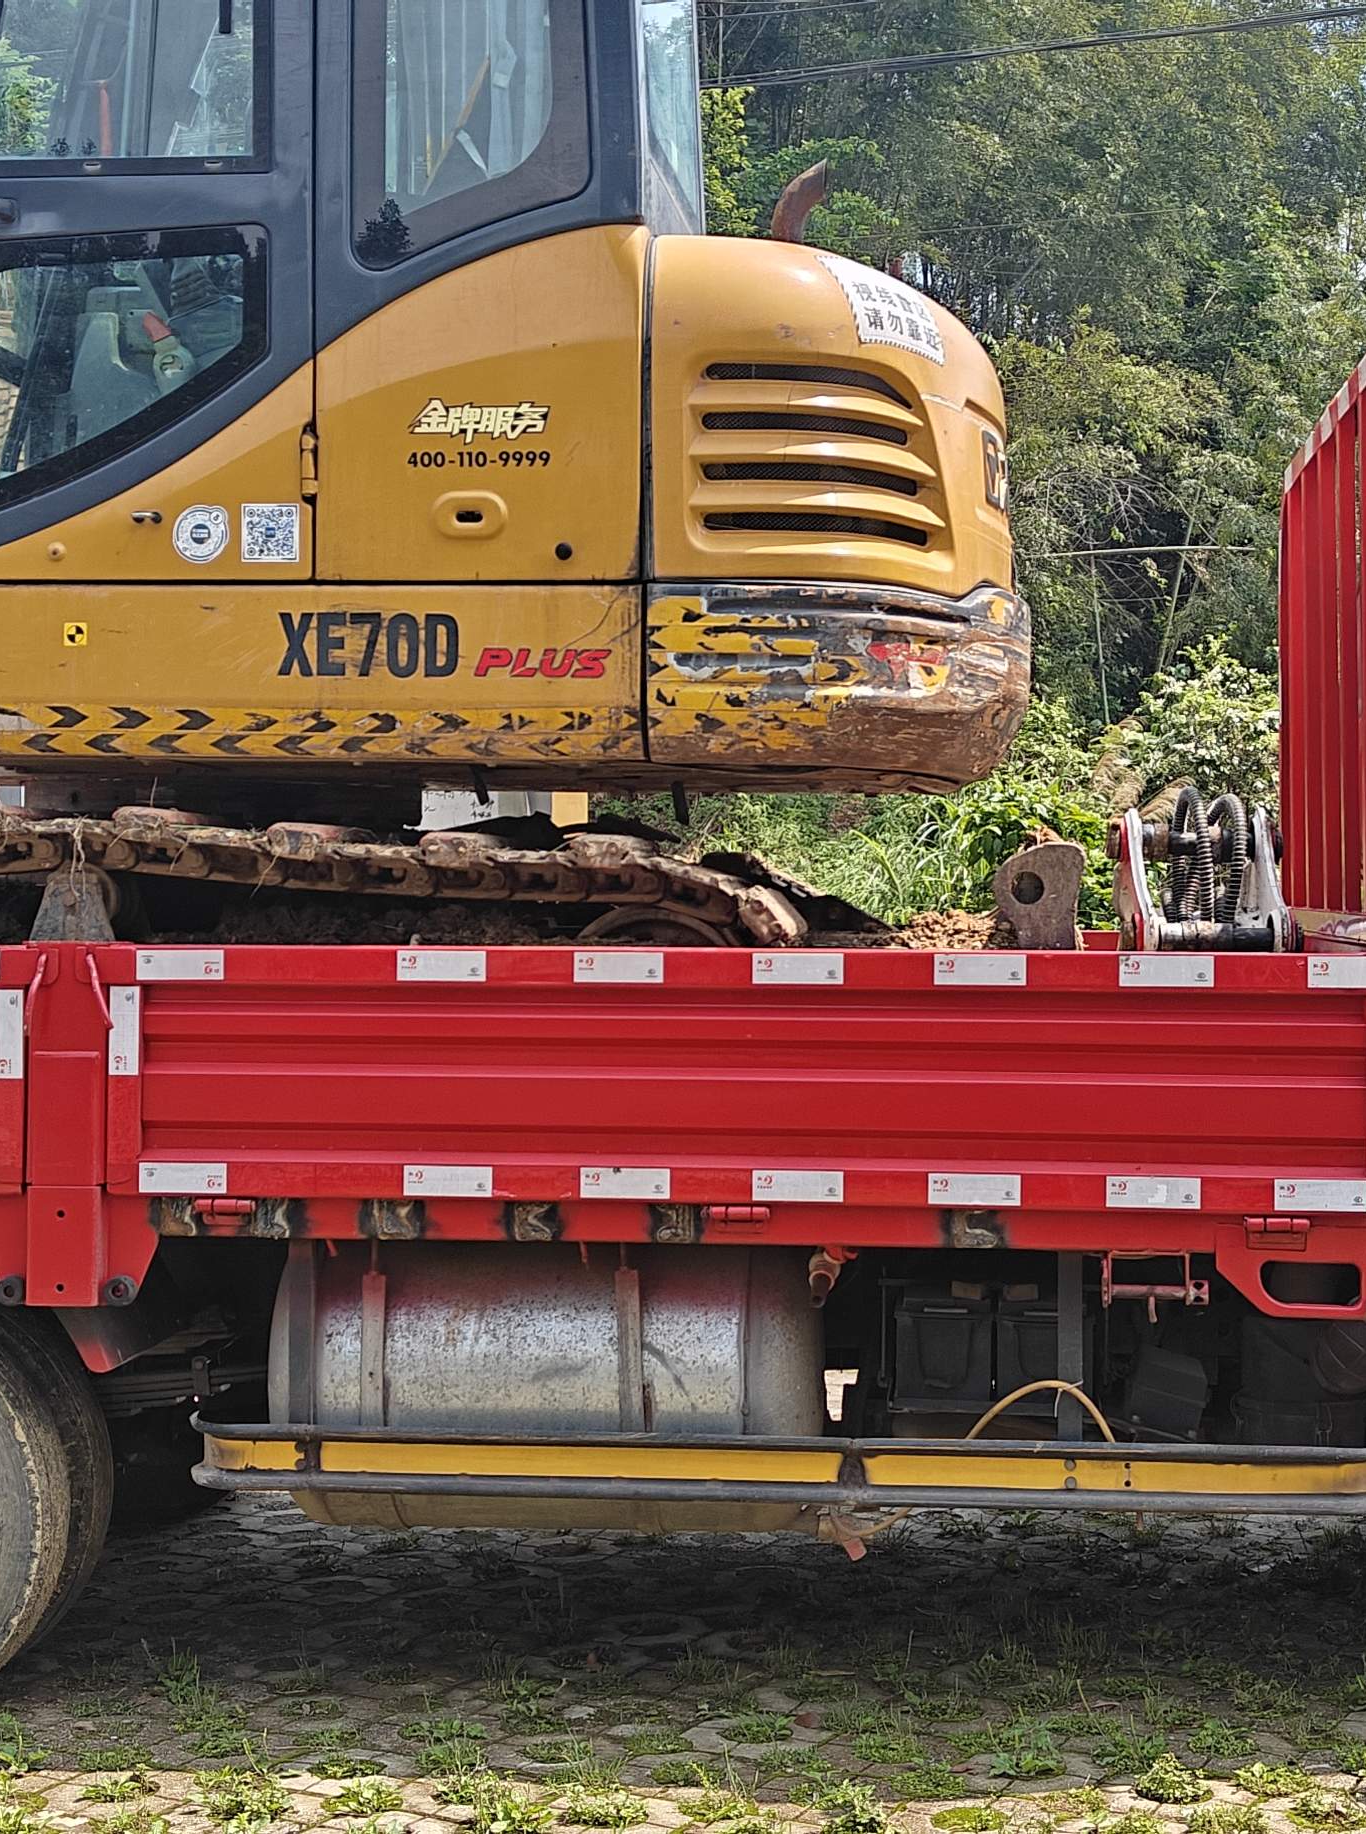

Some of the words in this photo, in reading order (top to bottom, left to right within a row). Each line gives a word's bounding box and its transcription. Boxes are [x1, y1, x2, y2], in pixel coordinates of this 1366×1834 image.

[863, 306, 941, 352] 请勿靠近
[407, 398, 551, 445] 金牌服务
[407, 451, 551, 467] 400-110-9999
[277, 612, 459, 678] XE70D
[473, 648, 612, 678] PLUS
